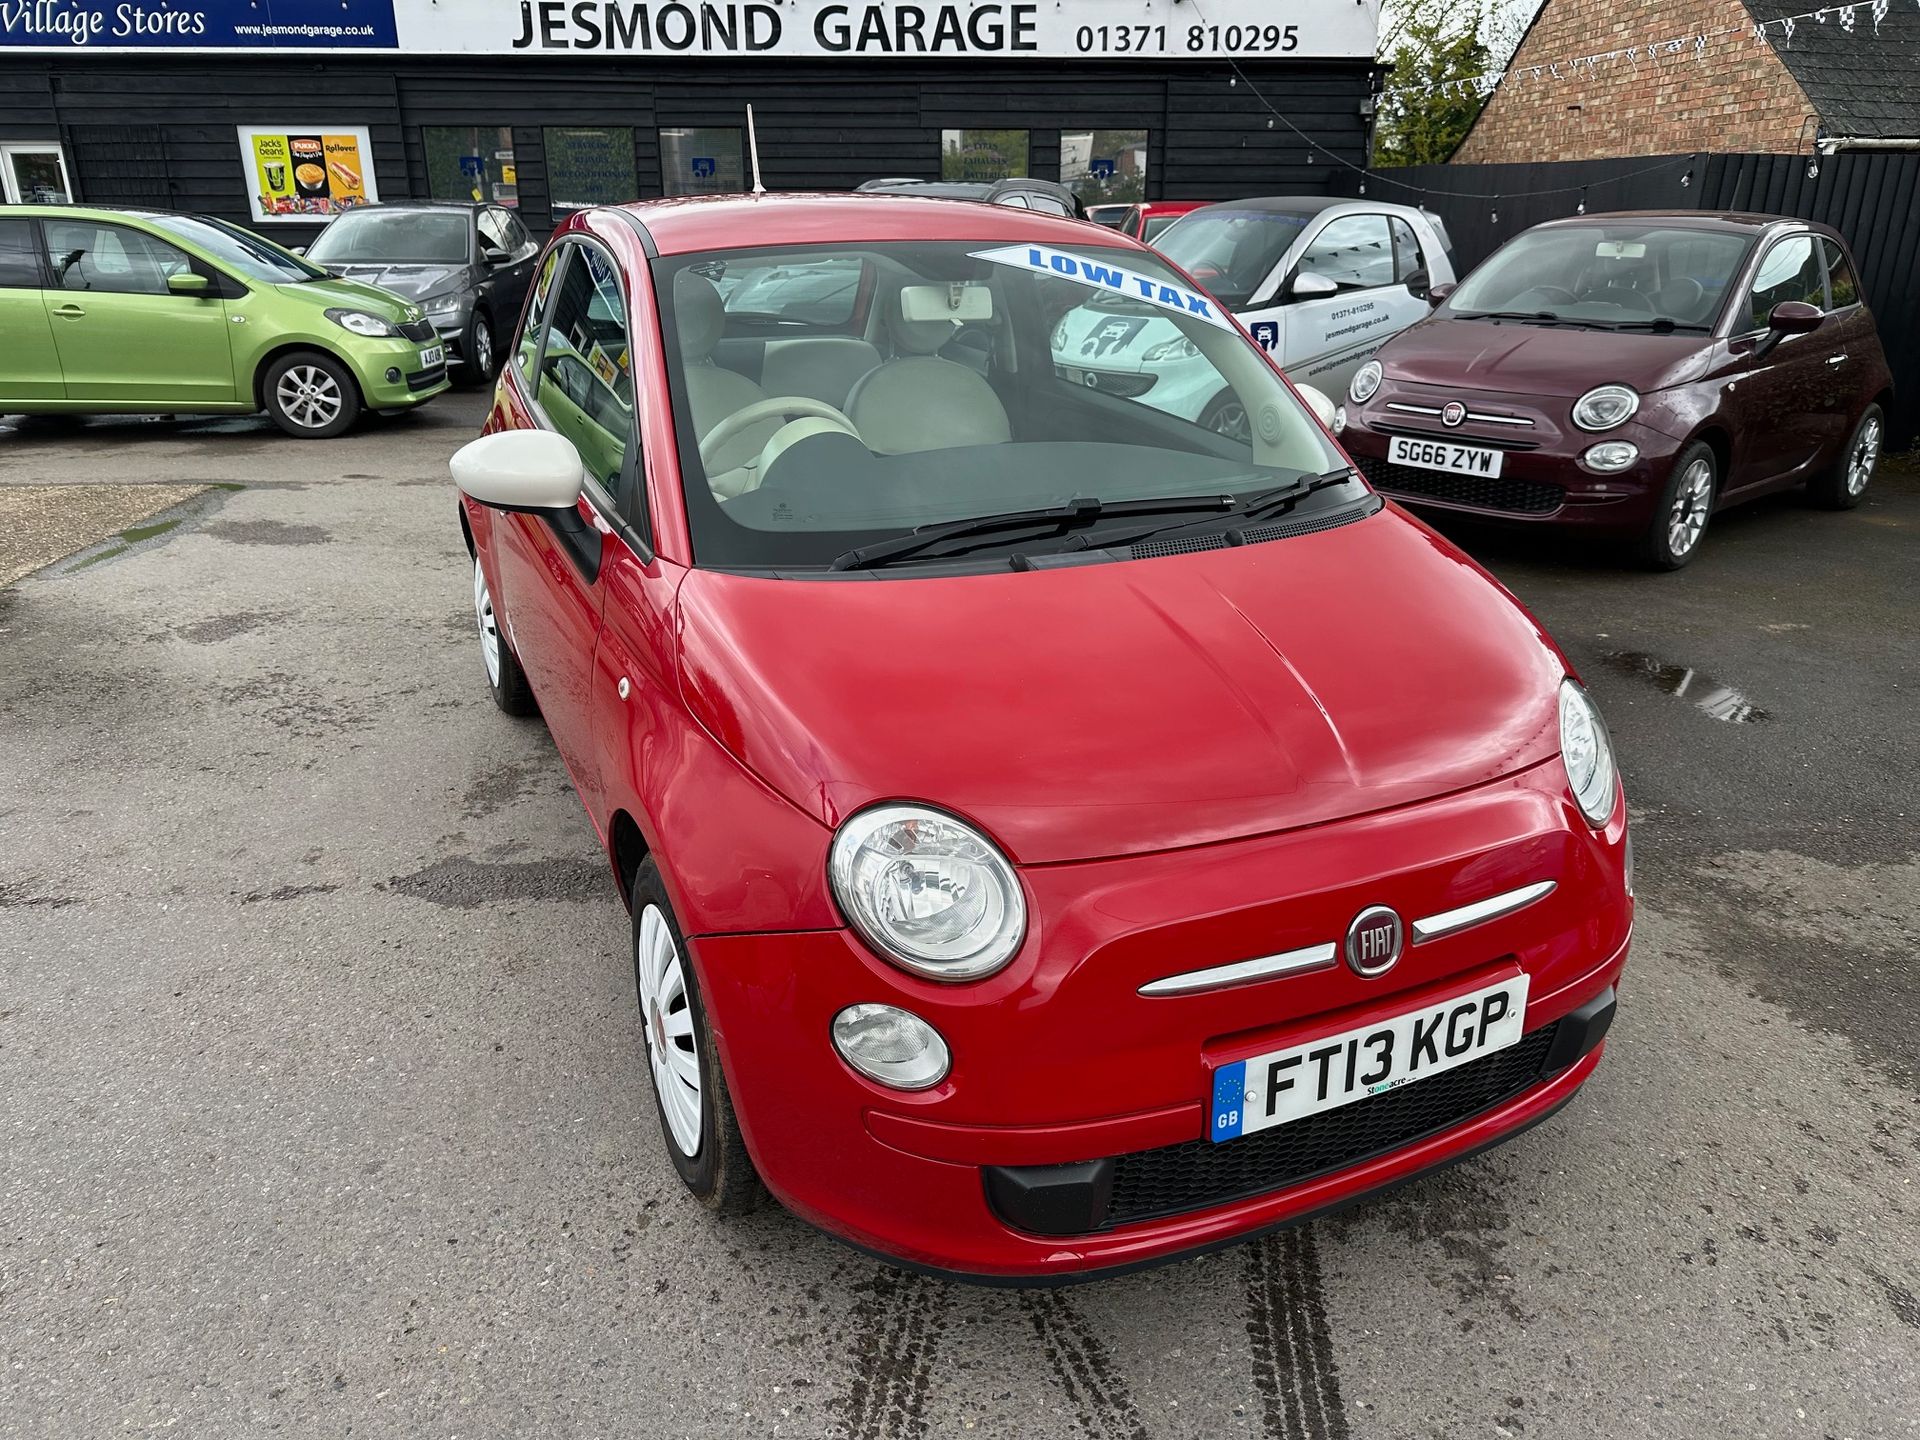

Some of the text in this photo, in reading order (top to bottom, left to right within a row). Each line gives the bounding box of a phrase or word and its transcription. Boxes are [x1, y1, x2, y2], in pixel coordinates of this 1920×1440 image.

[0, 0, 205, 45] Village Stores
[234, 23, 375, 37] www.jesmondgarage.co.uk
[513, 1, 1037, 52] JESMOND GARAGE
[1076, 25, 1299, 52] 01371 810295
[325, 144, 356, 152] Rollover
[1029, 249, 1213, 319] LOW TAX
[1331, 302, 1374, 320] 01371-810295
[1325, 314, 1389, 341] jesmondgarage.co.uk
[1446, 409, 1461, 420] FIAT
[1397, 441, 1493, 472] SG66 ZYW
[1361, 924, 1393, 960] FIAT
[1266, 991, 1509, 1116] FT13 KGP
[1367, 1077, 1406, 1095] Stoneacre
[1218, 1110, 1238, 1128] GB
